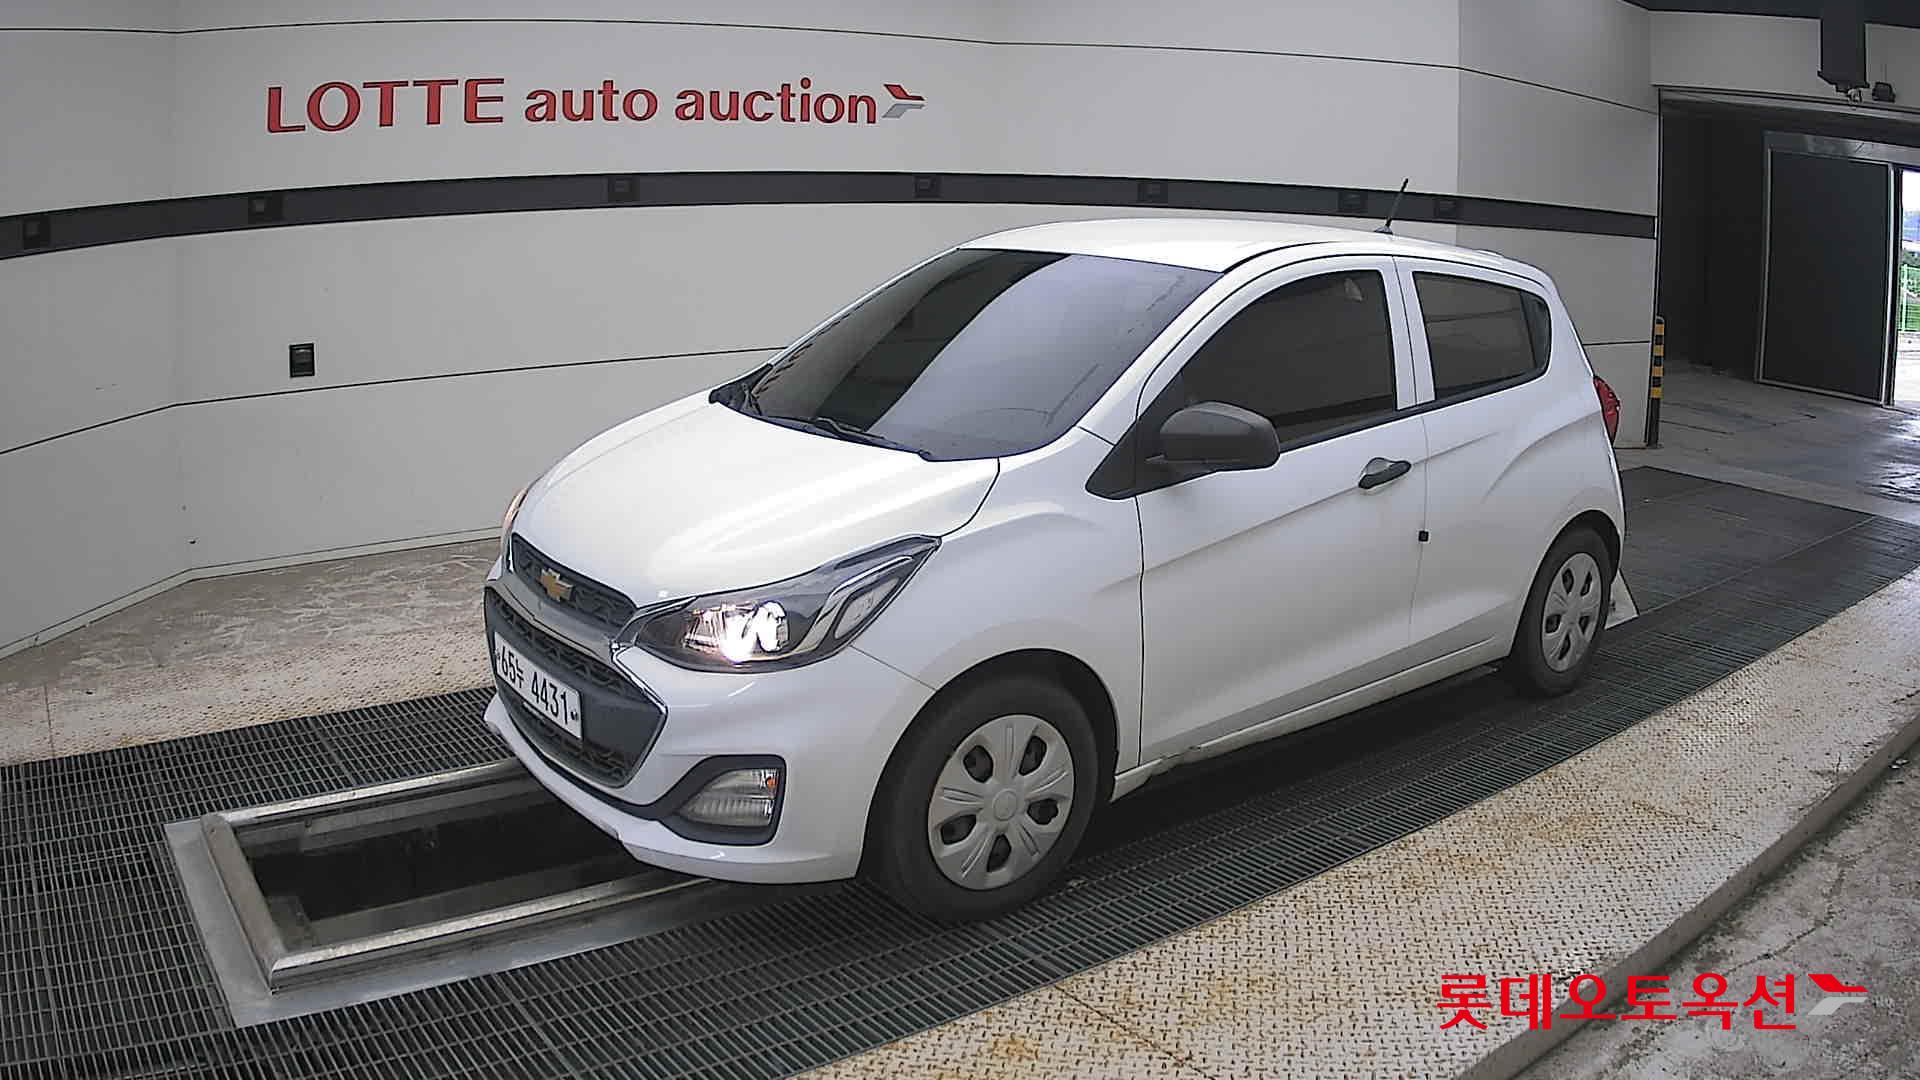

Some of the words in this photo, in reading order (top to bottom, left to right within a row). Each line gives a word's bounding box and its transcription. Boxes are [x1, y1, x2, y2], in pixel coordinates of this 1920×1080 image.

[266, 78, 505, 134] LOTTE
[525, 80, 659, 122] auto
[675, 77, 876, 125] auction
[501, 645, 525, 689] 65누
[531, 671, 568, 725] 4431
